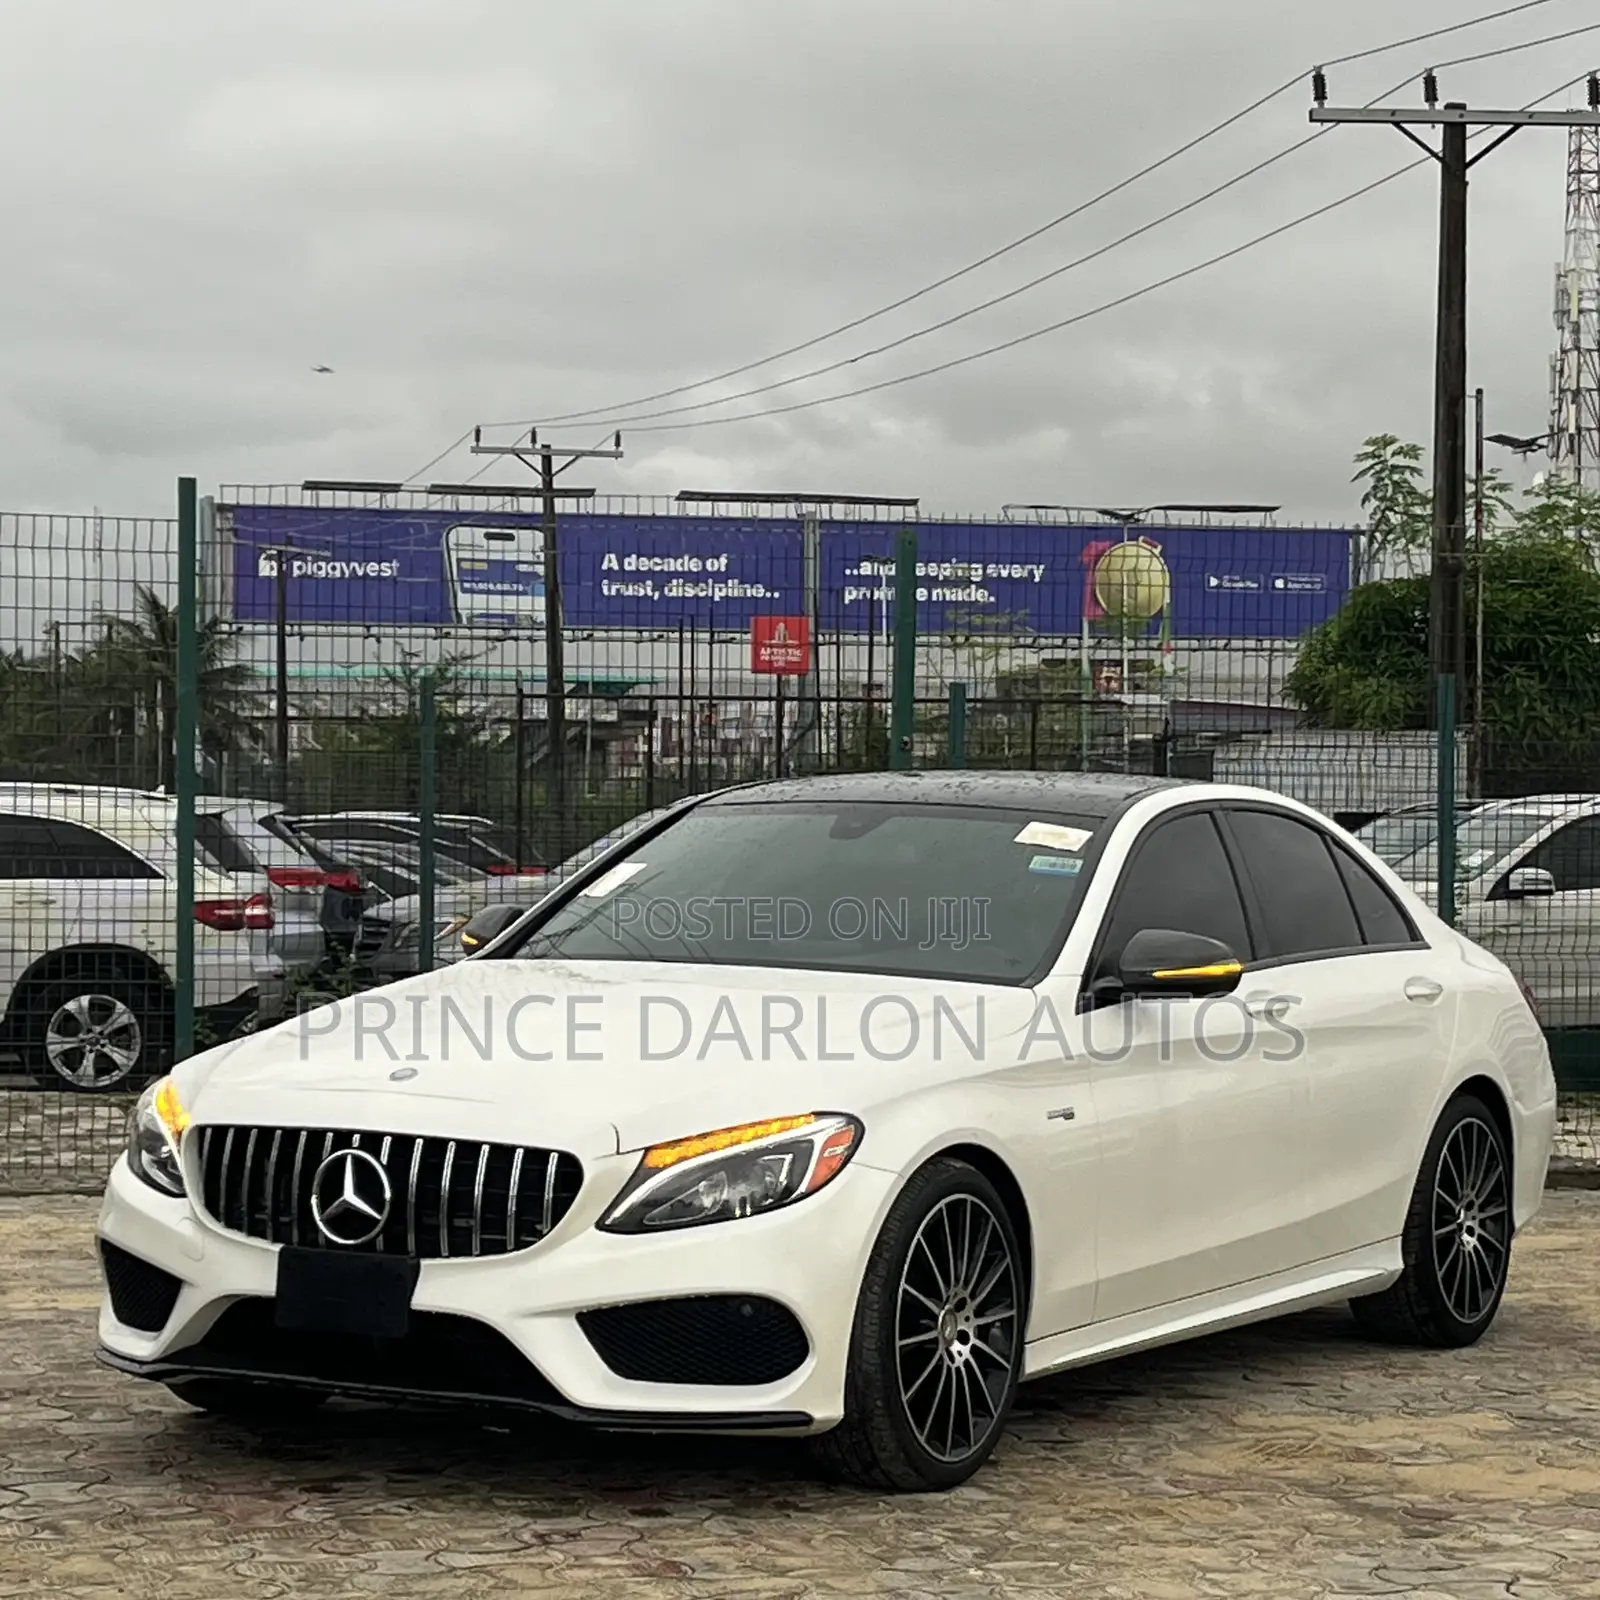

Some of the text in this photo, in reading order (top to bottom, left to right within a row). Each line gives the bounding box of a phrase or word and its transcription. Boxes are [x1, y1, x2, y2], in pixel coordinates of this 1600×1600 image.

[292, 556, 399, 578] piggyvest
[601, 553, 728, 572] A decade of
[914, 557, 983, 582] eeping
[986, 563, 1045, 582] every
[601, 579, 660, 601] trust,
[931, 584, 995, 603] made.
